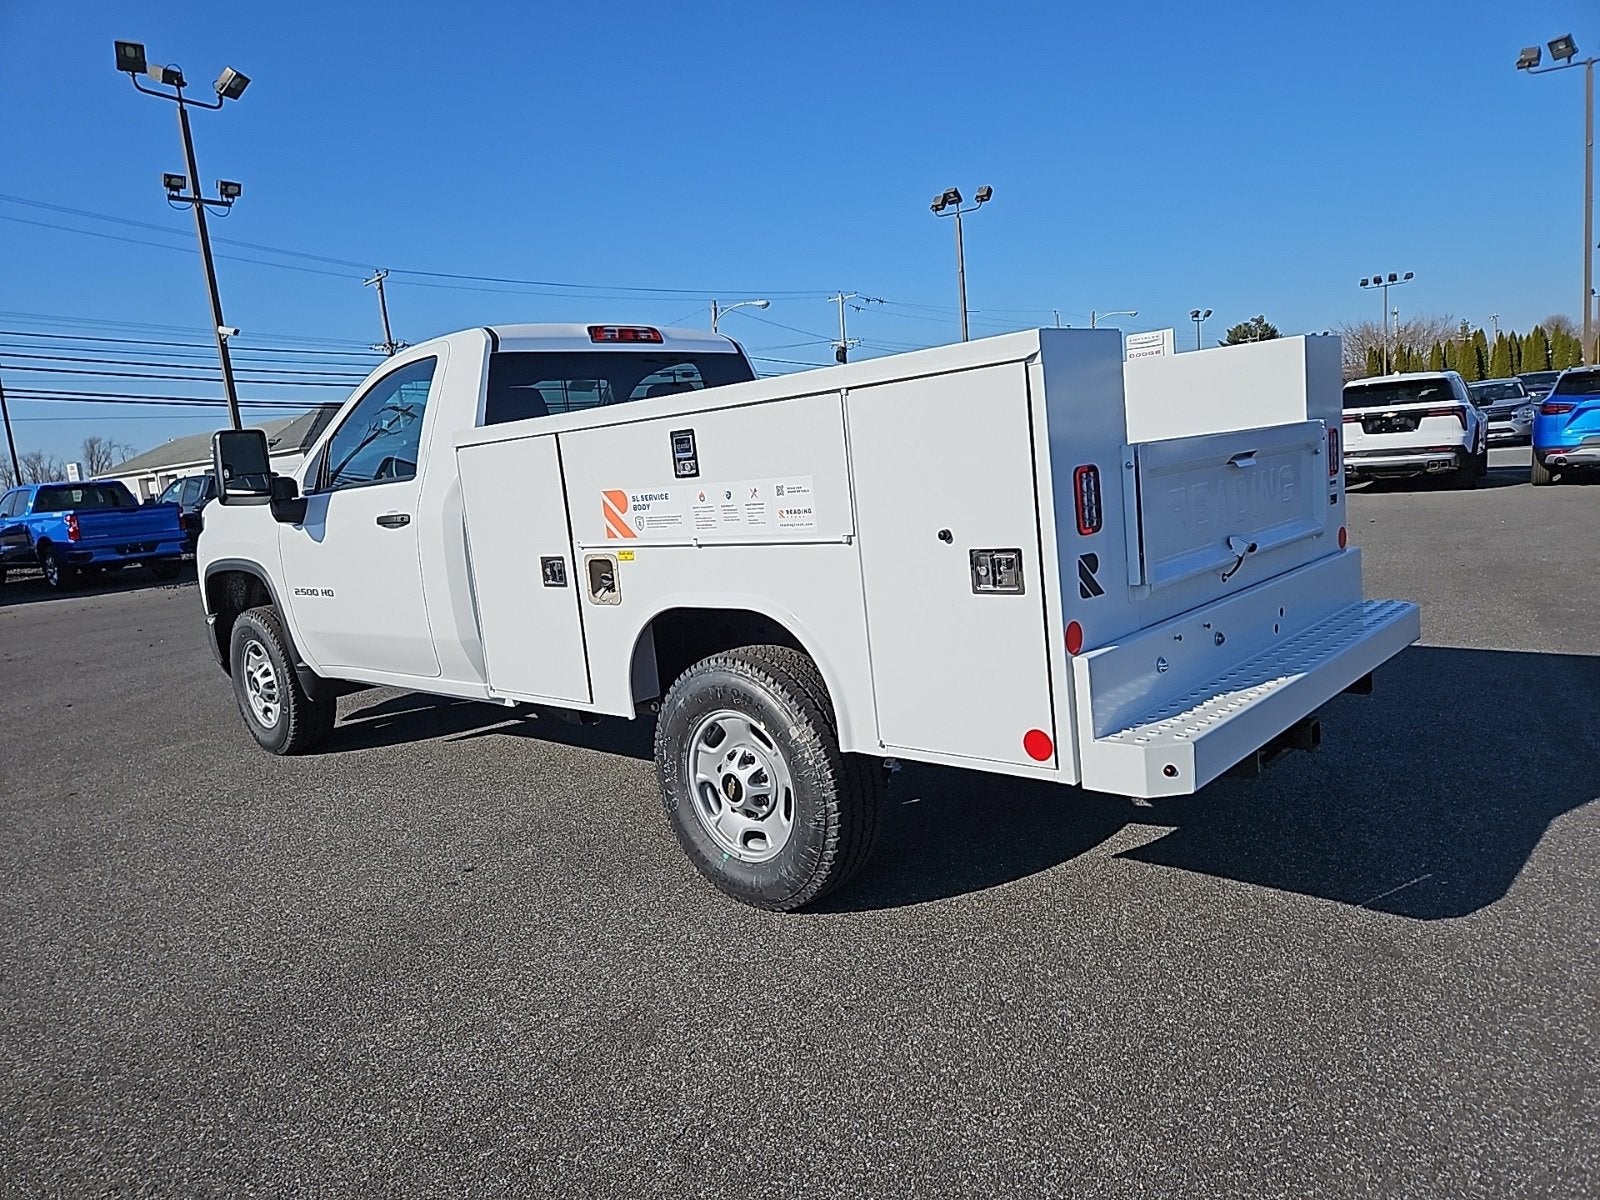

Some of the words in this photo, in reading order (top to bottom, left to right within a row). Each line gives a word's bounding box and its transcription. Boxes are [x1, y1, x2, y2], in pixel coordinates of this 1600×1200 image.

[1128, 349, 1162, 359] DODGE
[631, 495, 640, 503] SL
[640, 492, 670, 502] SERVICE
[1168, 464, 1296, 531] READING
[632, 503, 651, 512] BODY
[785, 507, 813, 515] READING
[294, 587, 319, 597] 2500
[320, 588, 335, 598] HD
